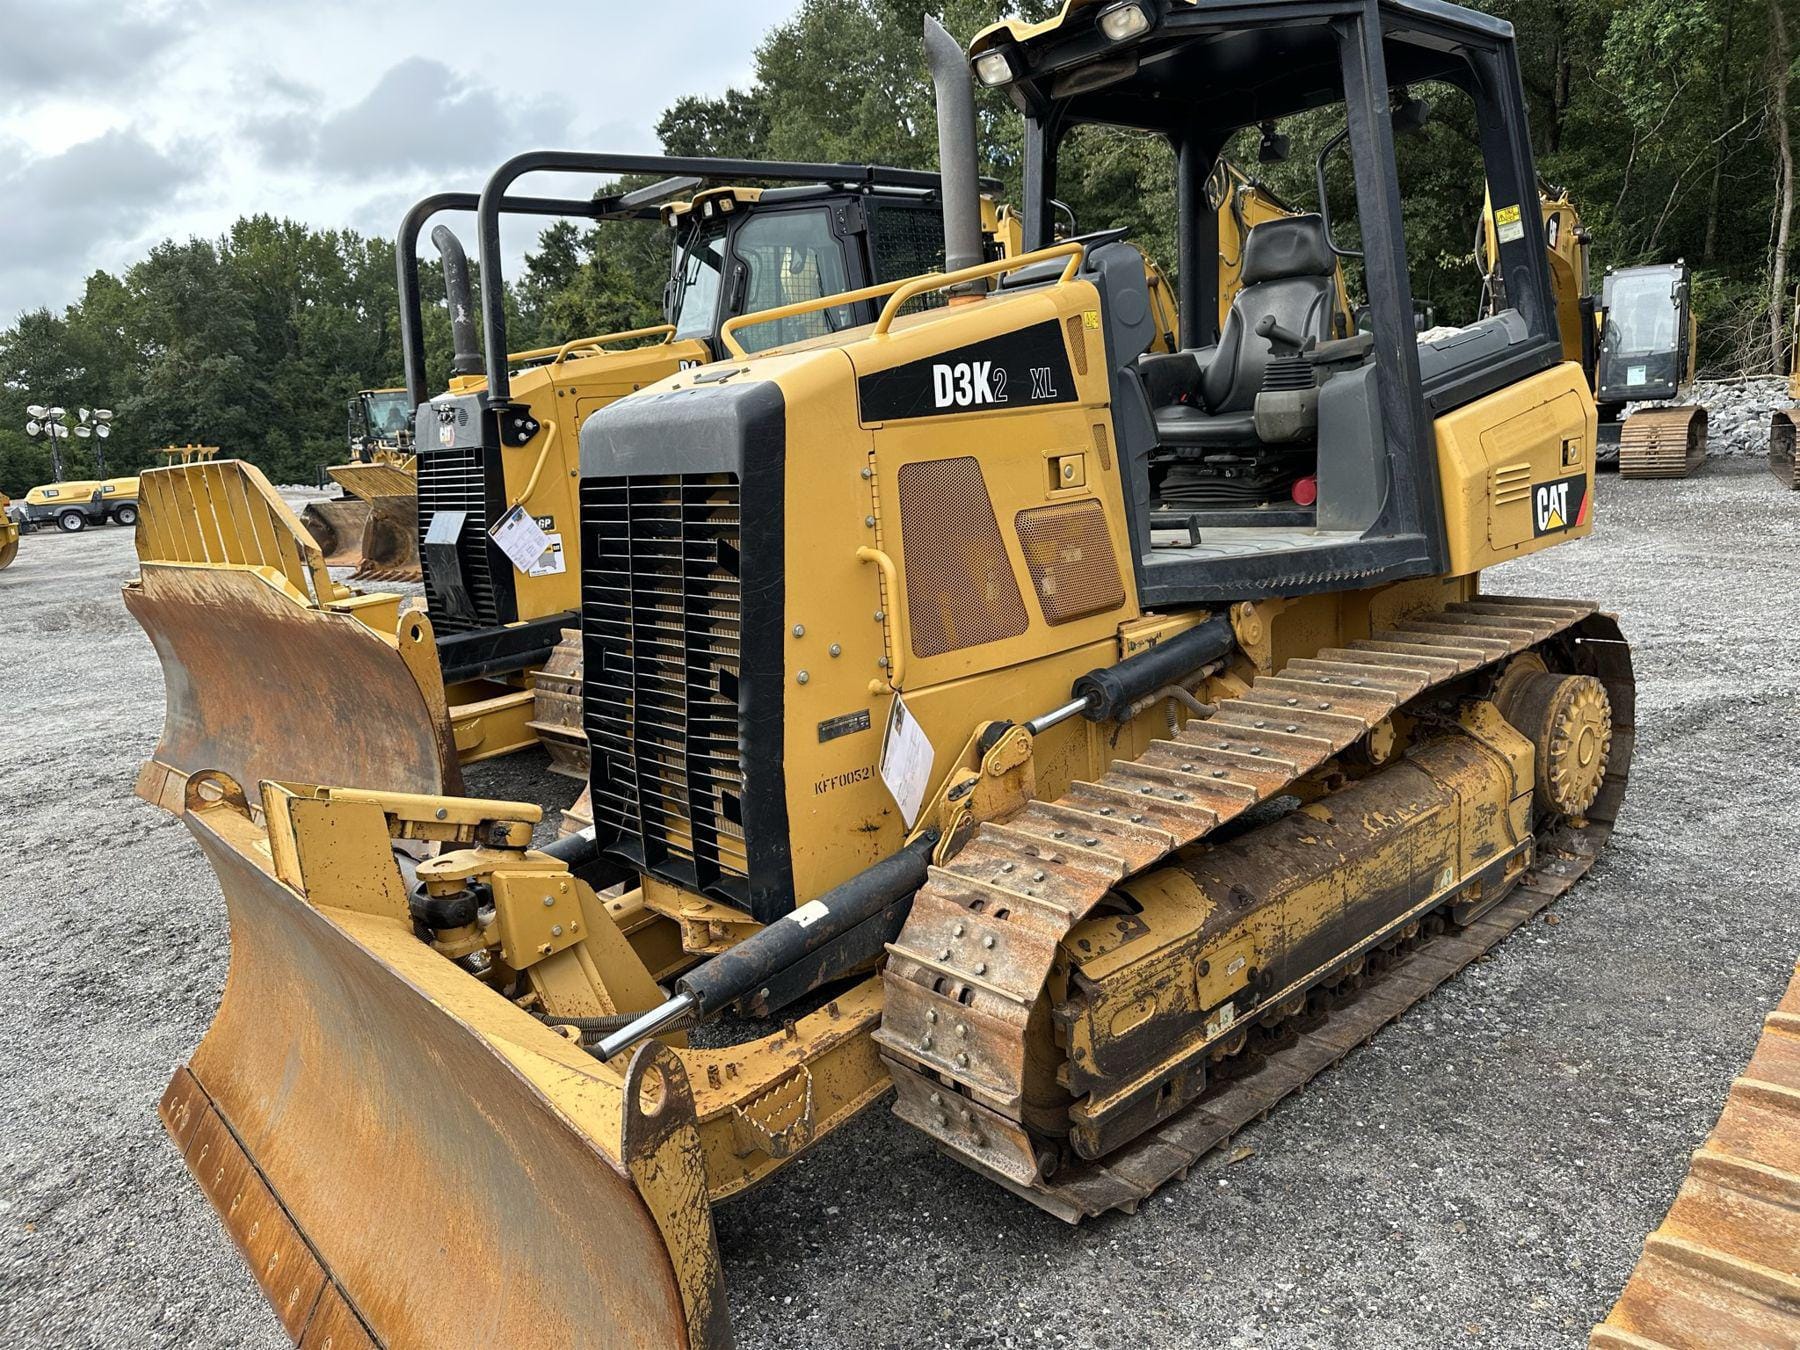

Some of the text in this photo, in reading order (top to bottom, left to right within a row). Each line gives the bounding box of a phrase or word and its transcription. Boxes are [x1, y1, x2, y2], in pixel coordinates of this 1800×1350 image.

[932, 360, 1058, 408] D3K2 XL
[1536, 482, 1569, 532] CAT
[814, 764, 876, 795] KFF00521
